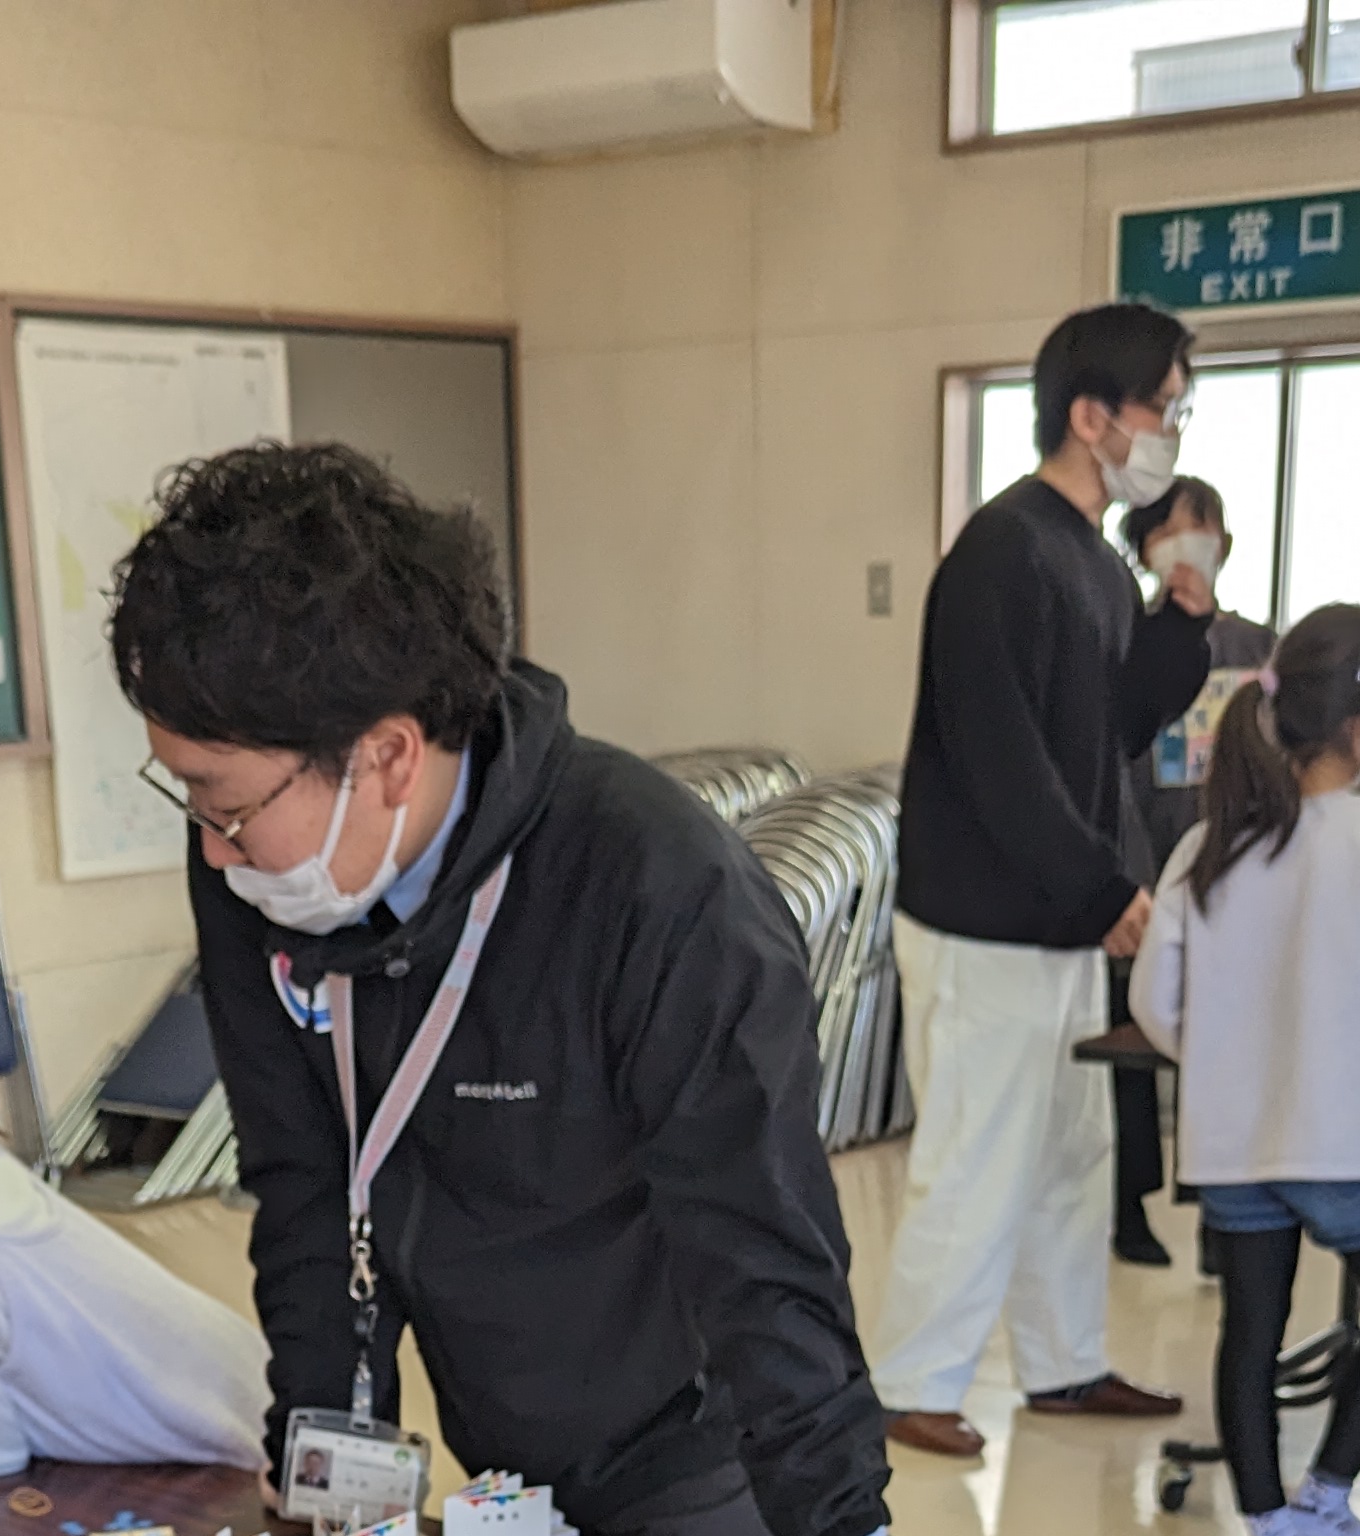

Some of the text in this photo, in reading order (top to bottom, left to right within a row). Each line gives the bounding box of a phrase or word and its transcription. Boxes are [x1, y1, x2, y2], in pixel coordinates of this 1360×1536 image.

[1159, 202, 1343, 273] 非常口
[1200, 266, 1294, 303] EXIT
